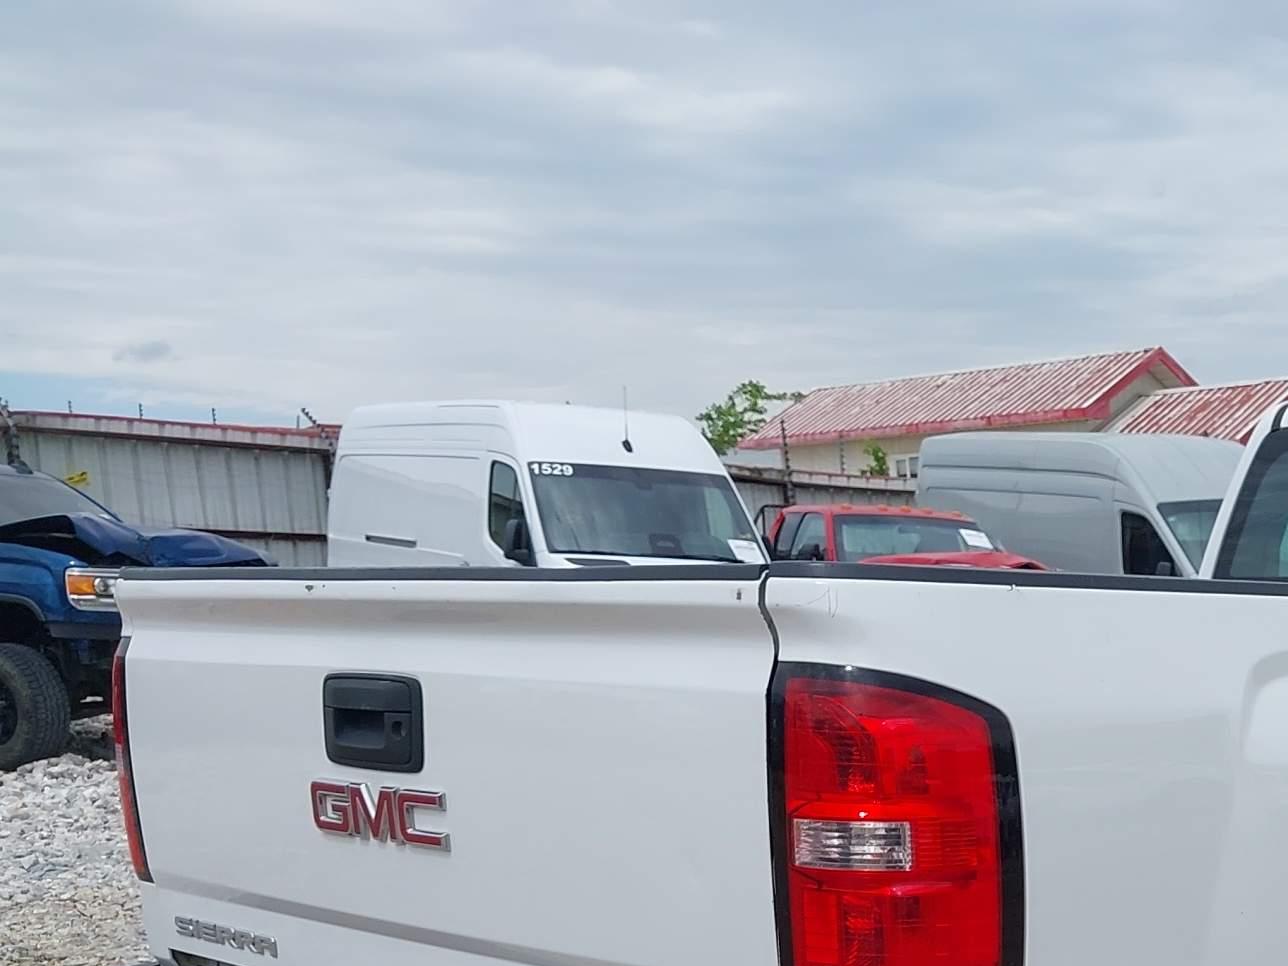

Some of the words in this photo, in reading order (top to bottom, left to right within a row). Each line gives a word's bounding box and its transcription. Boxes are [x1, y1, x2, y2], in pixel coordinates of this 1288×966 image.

[530, 462, 574, 476] 1529
[310, 779, 451, 852] GMC
[174, 915, 278, 959] SIERRA
